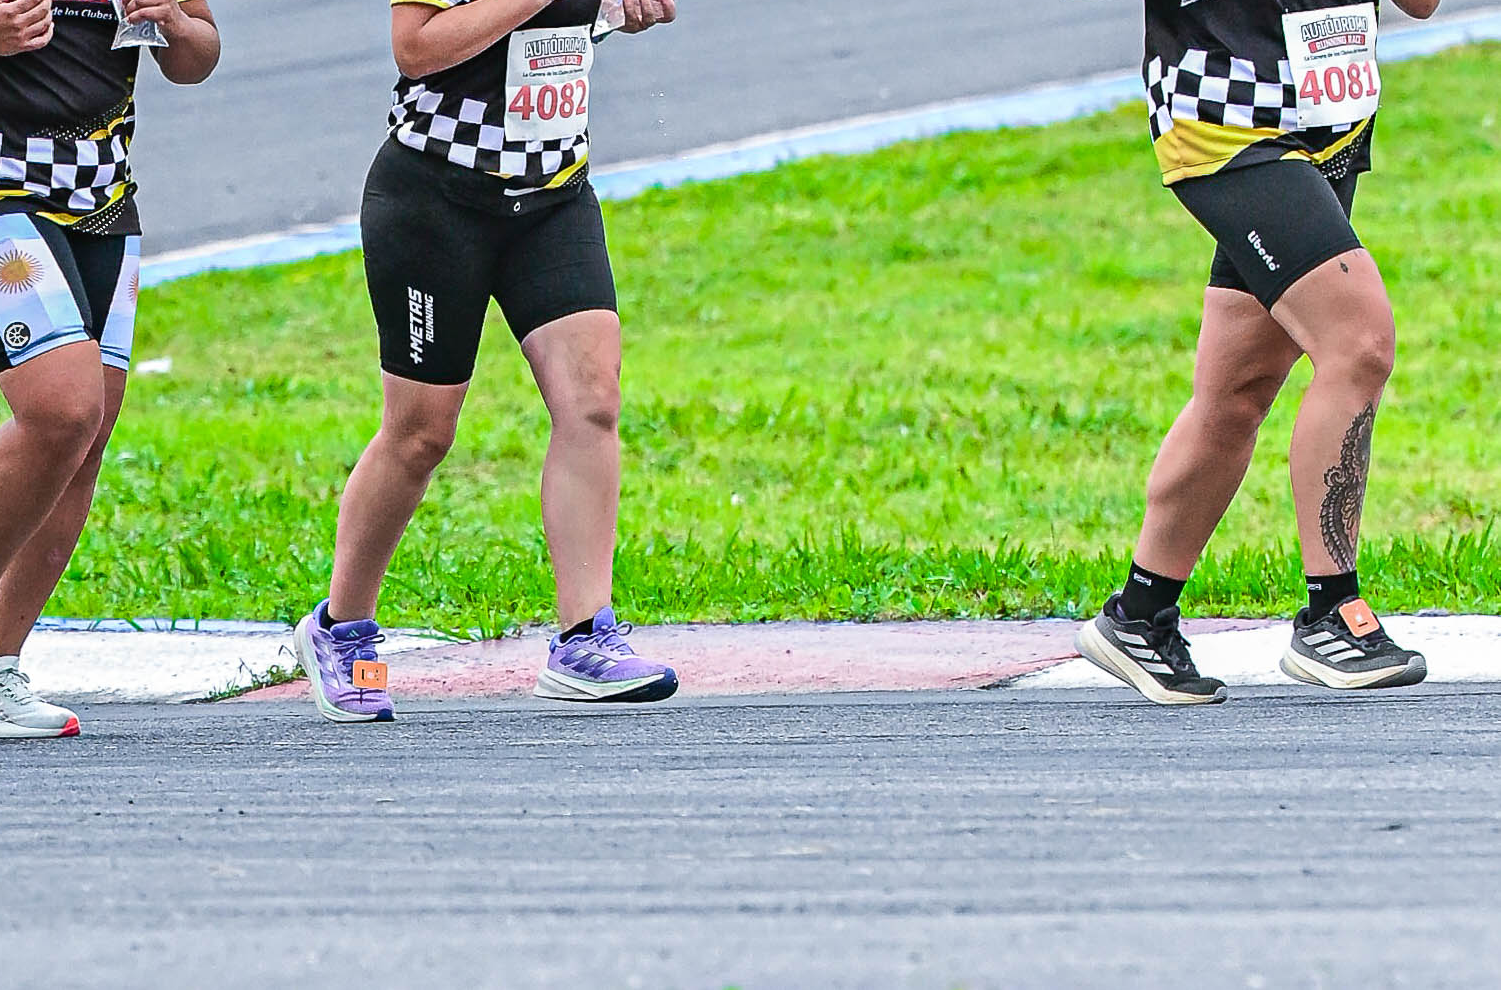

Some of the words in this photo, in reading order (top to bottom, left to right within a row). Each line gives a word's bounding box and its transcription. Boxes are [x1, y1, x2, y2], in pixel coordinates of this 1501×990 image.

[52, 6, 63, 16] de
[65, 7, 79, 16] los
[81, 9, 112, 20] Clubes
[1300, 14, 1368, 42] AUTÓDROMO
[524, 34, 586, 58] AUTÓDROMO
[508, 79, 586, 120] 4082
[1299, 60, 1377, 105] 4081
[424, 293, 434, 344] RUNNING
